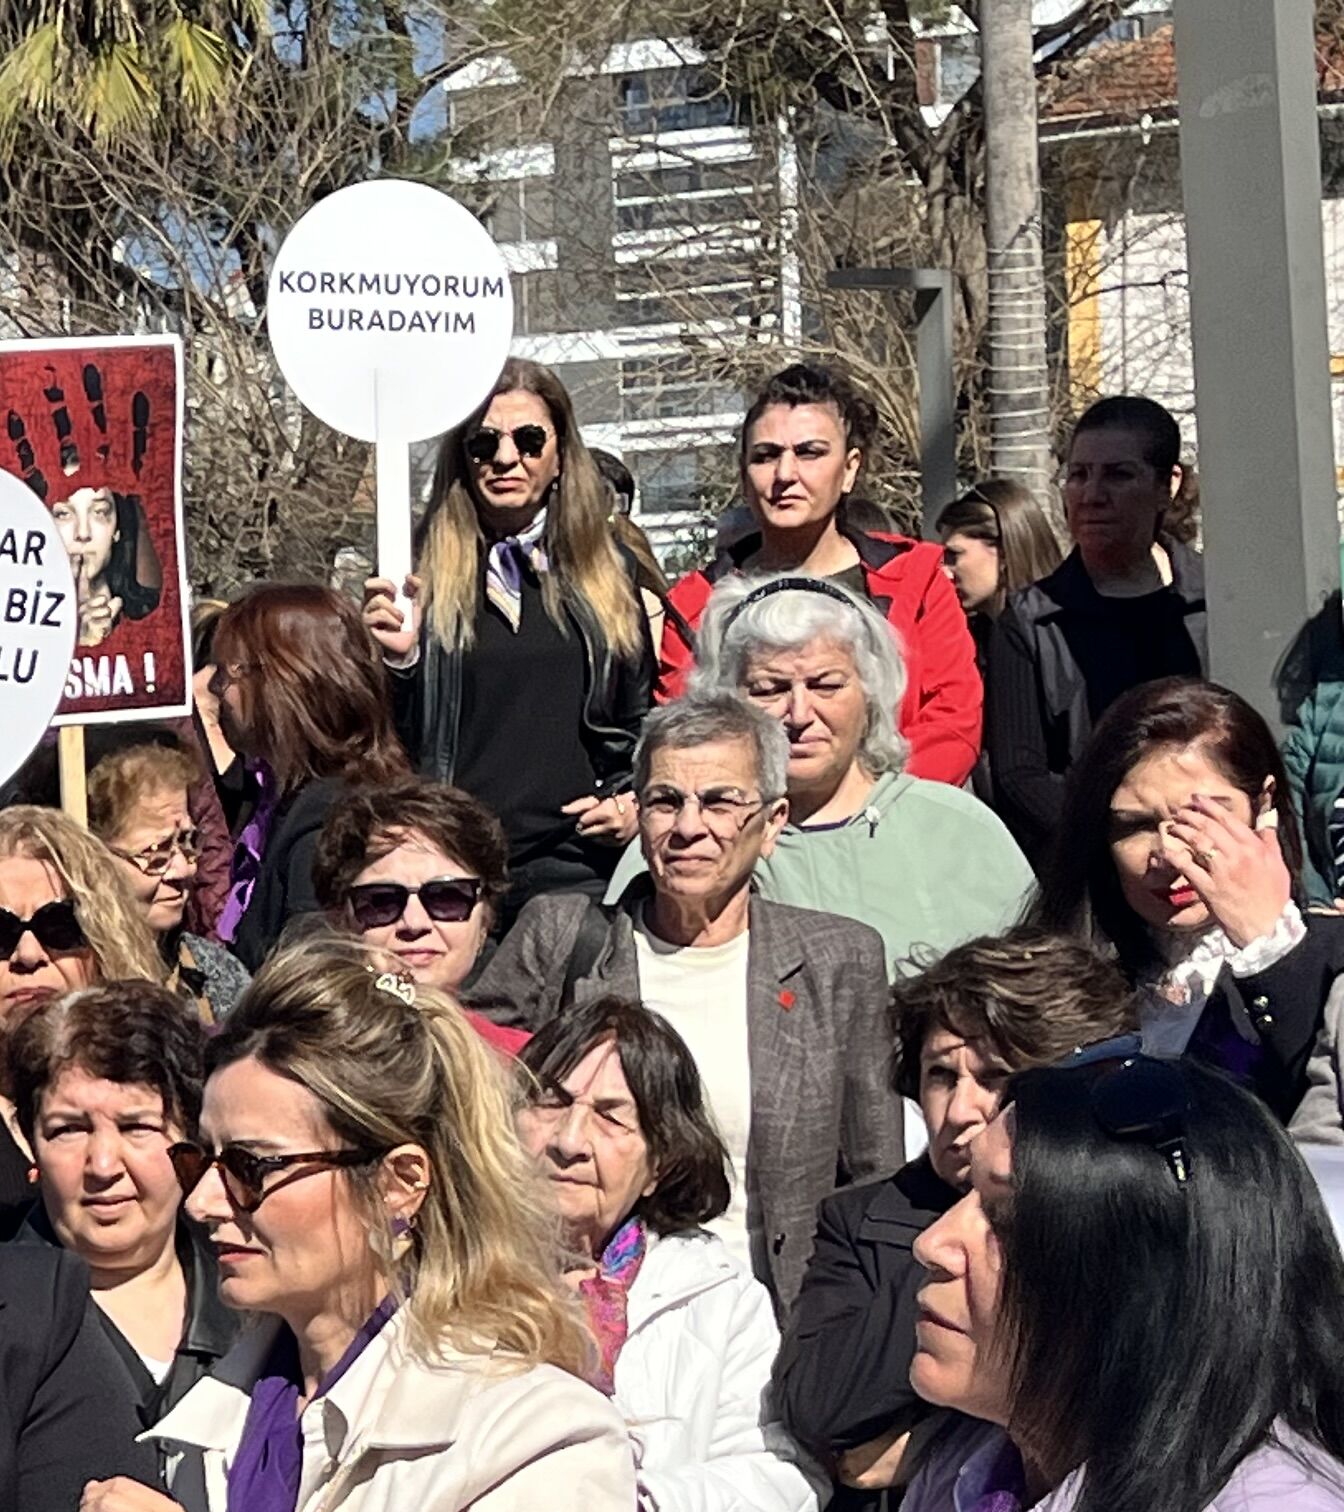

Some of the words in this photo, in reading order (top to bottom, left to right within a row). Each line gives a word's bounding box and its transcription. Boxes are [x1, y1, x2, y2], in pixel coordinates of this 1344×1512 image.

[279, 271, 504, 298] KORKMUYORUM
[309, 308, 475, 334] BURADAYIM
[4, 588, 66, 628] BİZ
[64, 654, 134, 699] SMA
